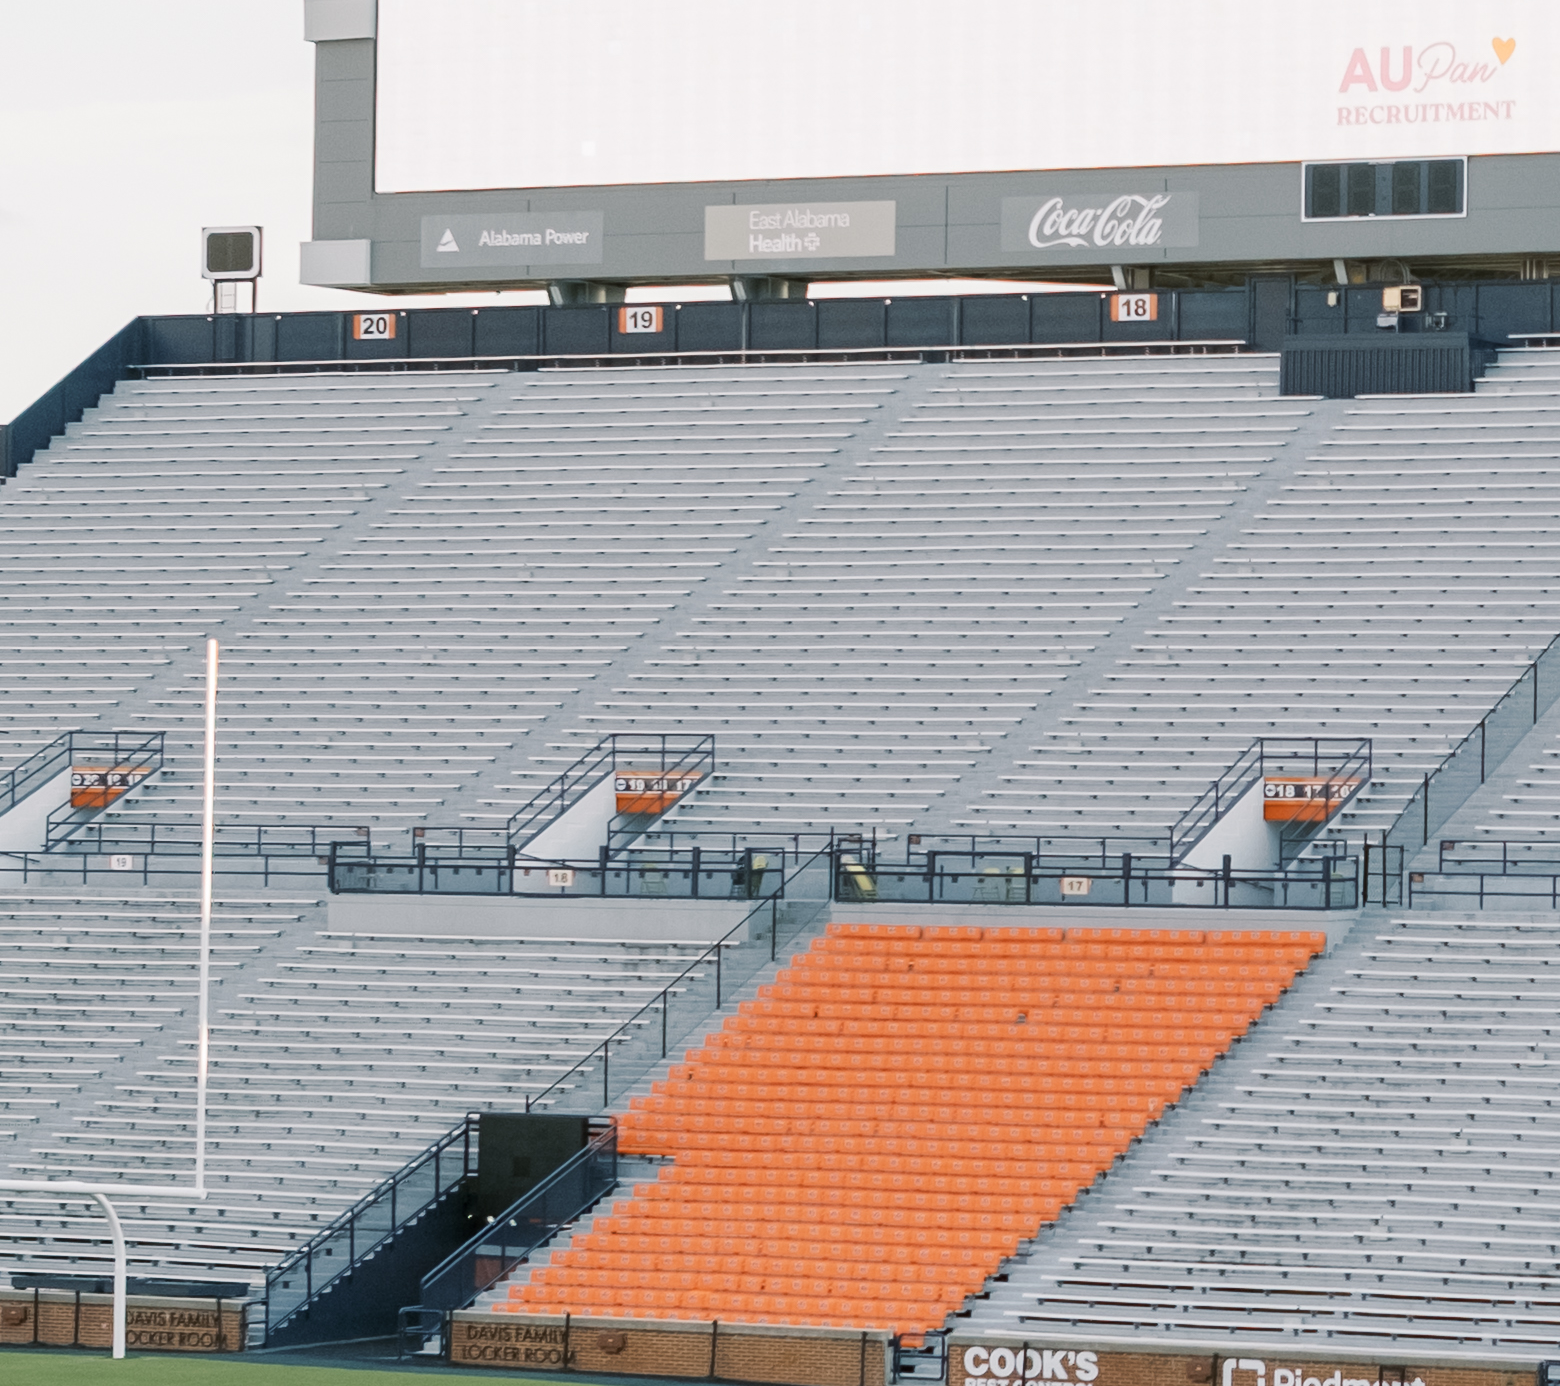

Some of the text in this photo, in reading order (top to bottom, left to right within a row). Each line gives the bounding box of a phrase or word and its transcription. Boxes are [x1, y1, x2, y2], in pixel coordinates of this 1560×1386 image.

[1337, 100, 1517, 126] RECRUITMENT
[749, 209, 850, 230] East Alabama
[479, 228, 589, 247] Alabama Power
[749, 233, 802, 253] Health
[1122, 298, 1146, 317] 18
[362, 317, 388, 336] 20
[629, 311, 653, 330] 19
[1276, 785, 1295, 797] 18
[1068, 881, 1083, 892] 17
[126, 1330, 176, 1347] OCKER
[467, 1325, 567, 1345] DAVIS FAMILY
[462, 1345, 520, 1362] LOCKER
[964, 1346, 1099, 1382] COOK'S
